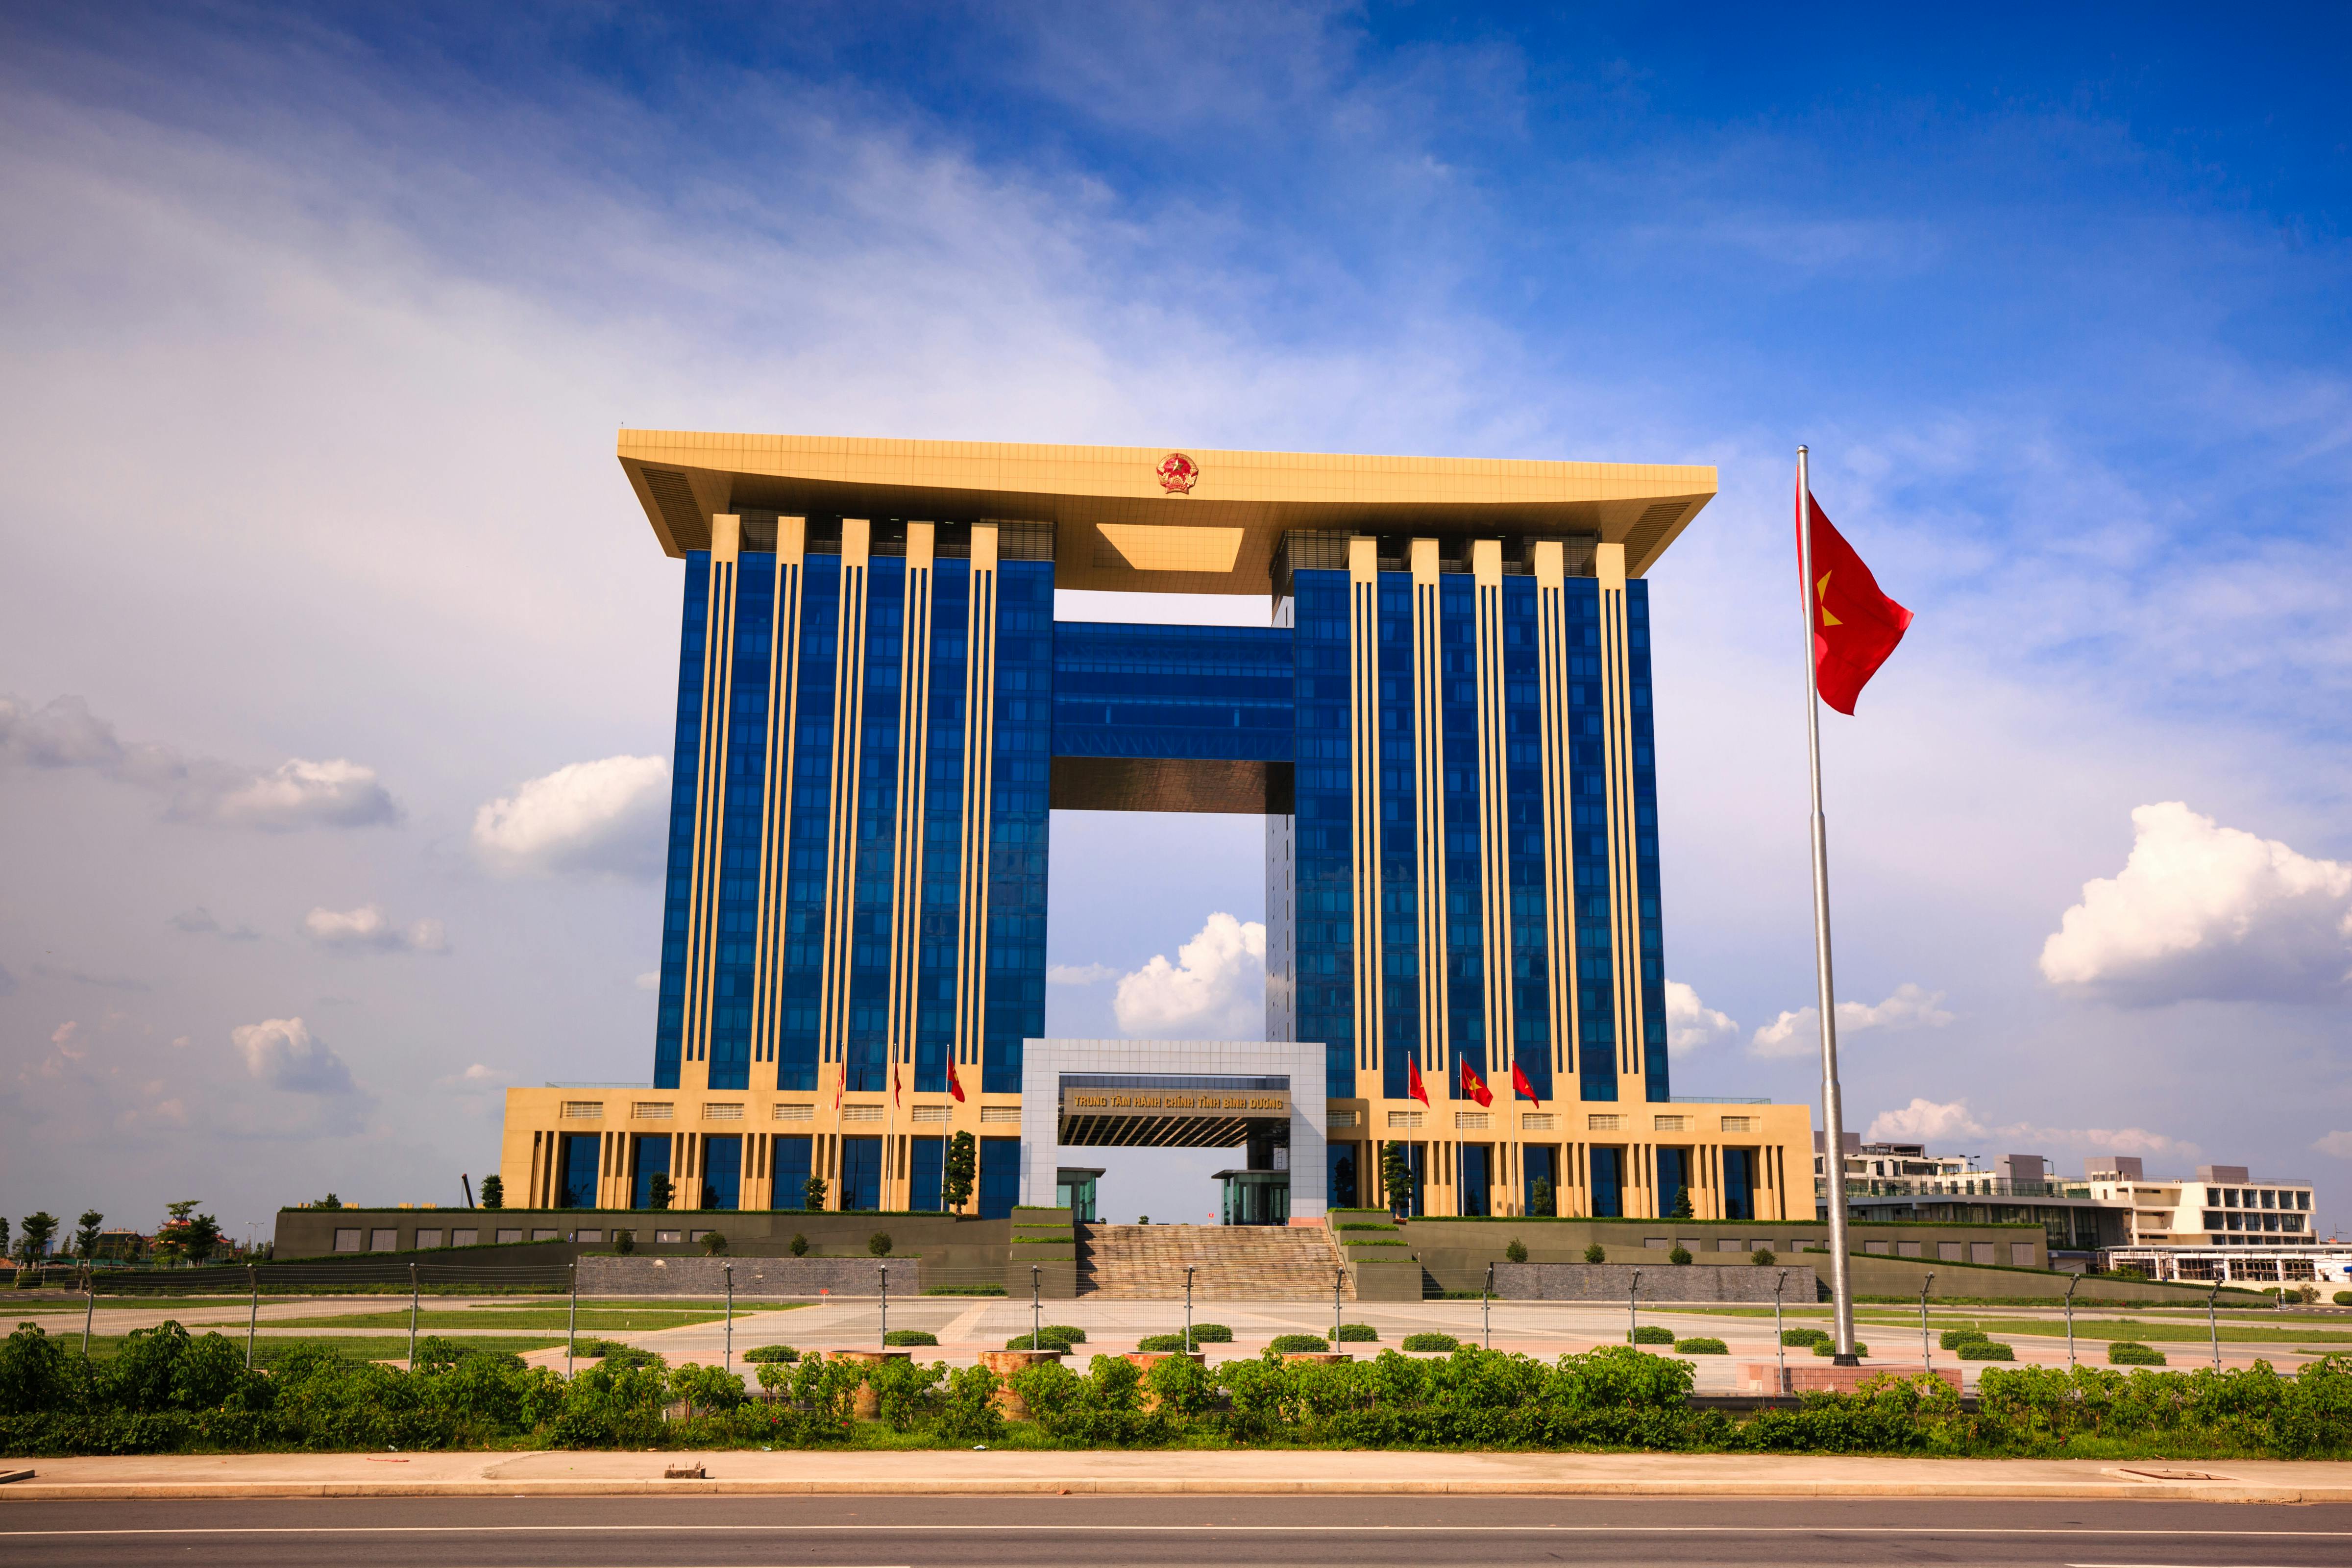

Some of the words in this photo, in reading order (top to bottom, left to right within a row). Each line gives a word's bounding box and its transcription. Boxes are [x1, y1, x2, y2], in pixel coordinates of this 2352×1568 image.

[1074, 1096, 1106, 1107] TRUNG
[1110, 1094, 1131, 1107] TÂM
[1134, 1094, 1161, 1107] HÀNH
[1165, 1094, 1194, 1108] CHÍNH
[1224, 1095, 1247, 1109] BÌNH
